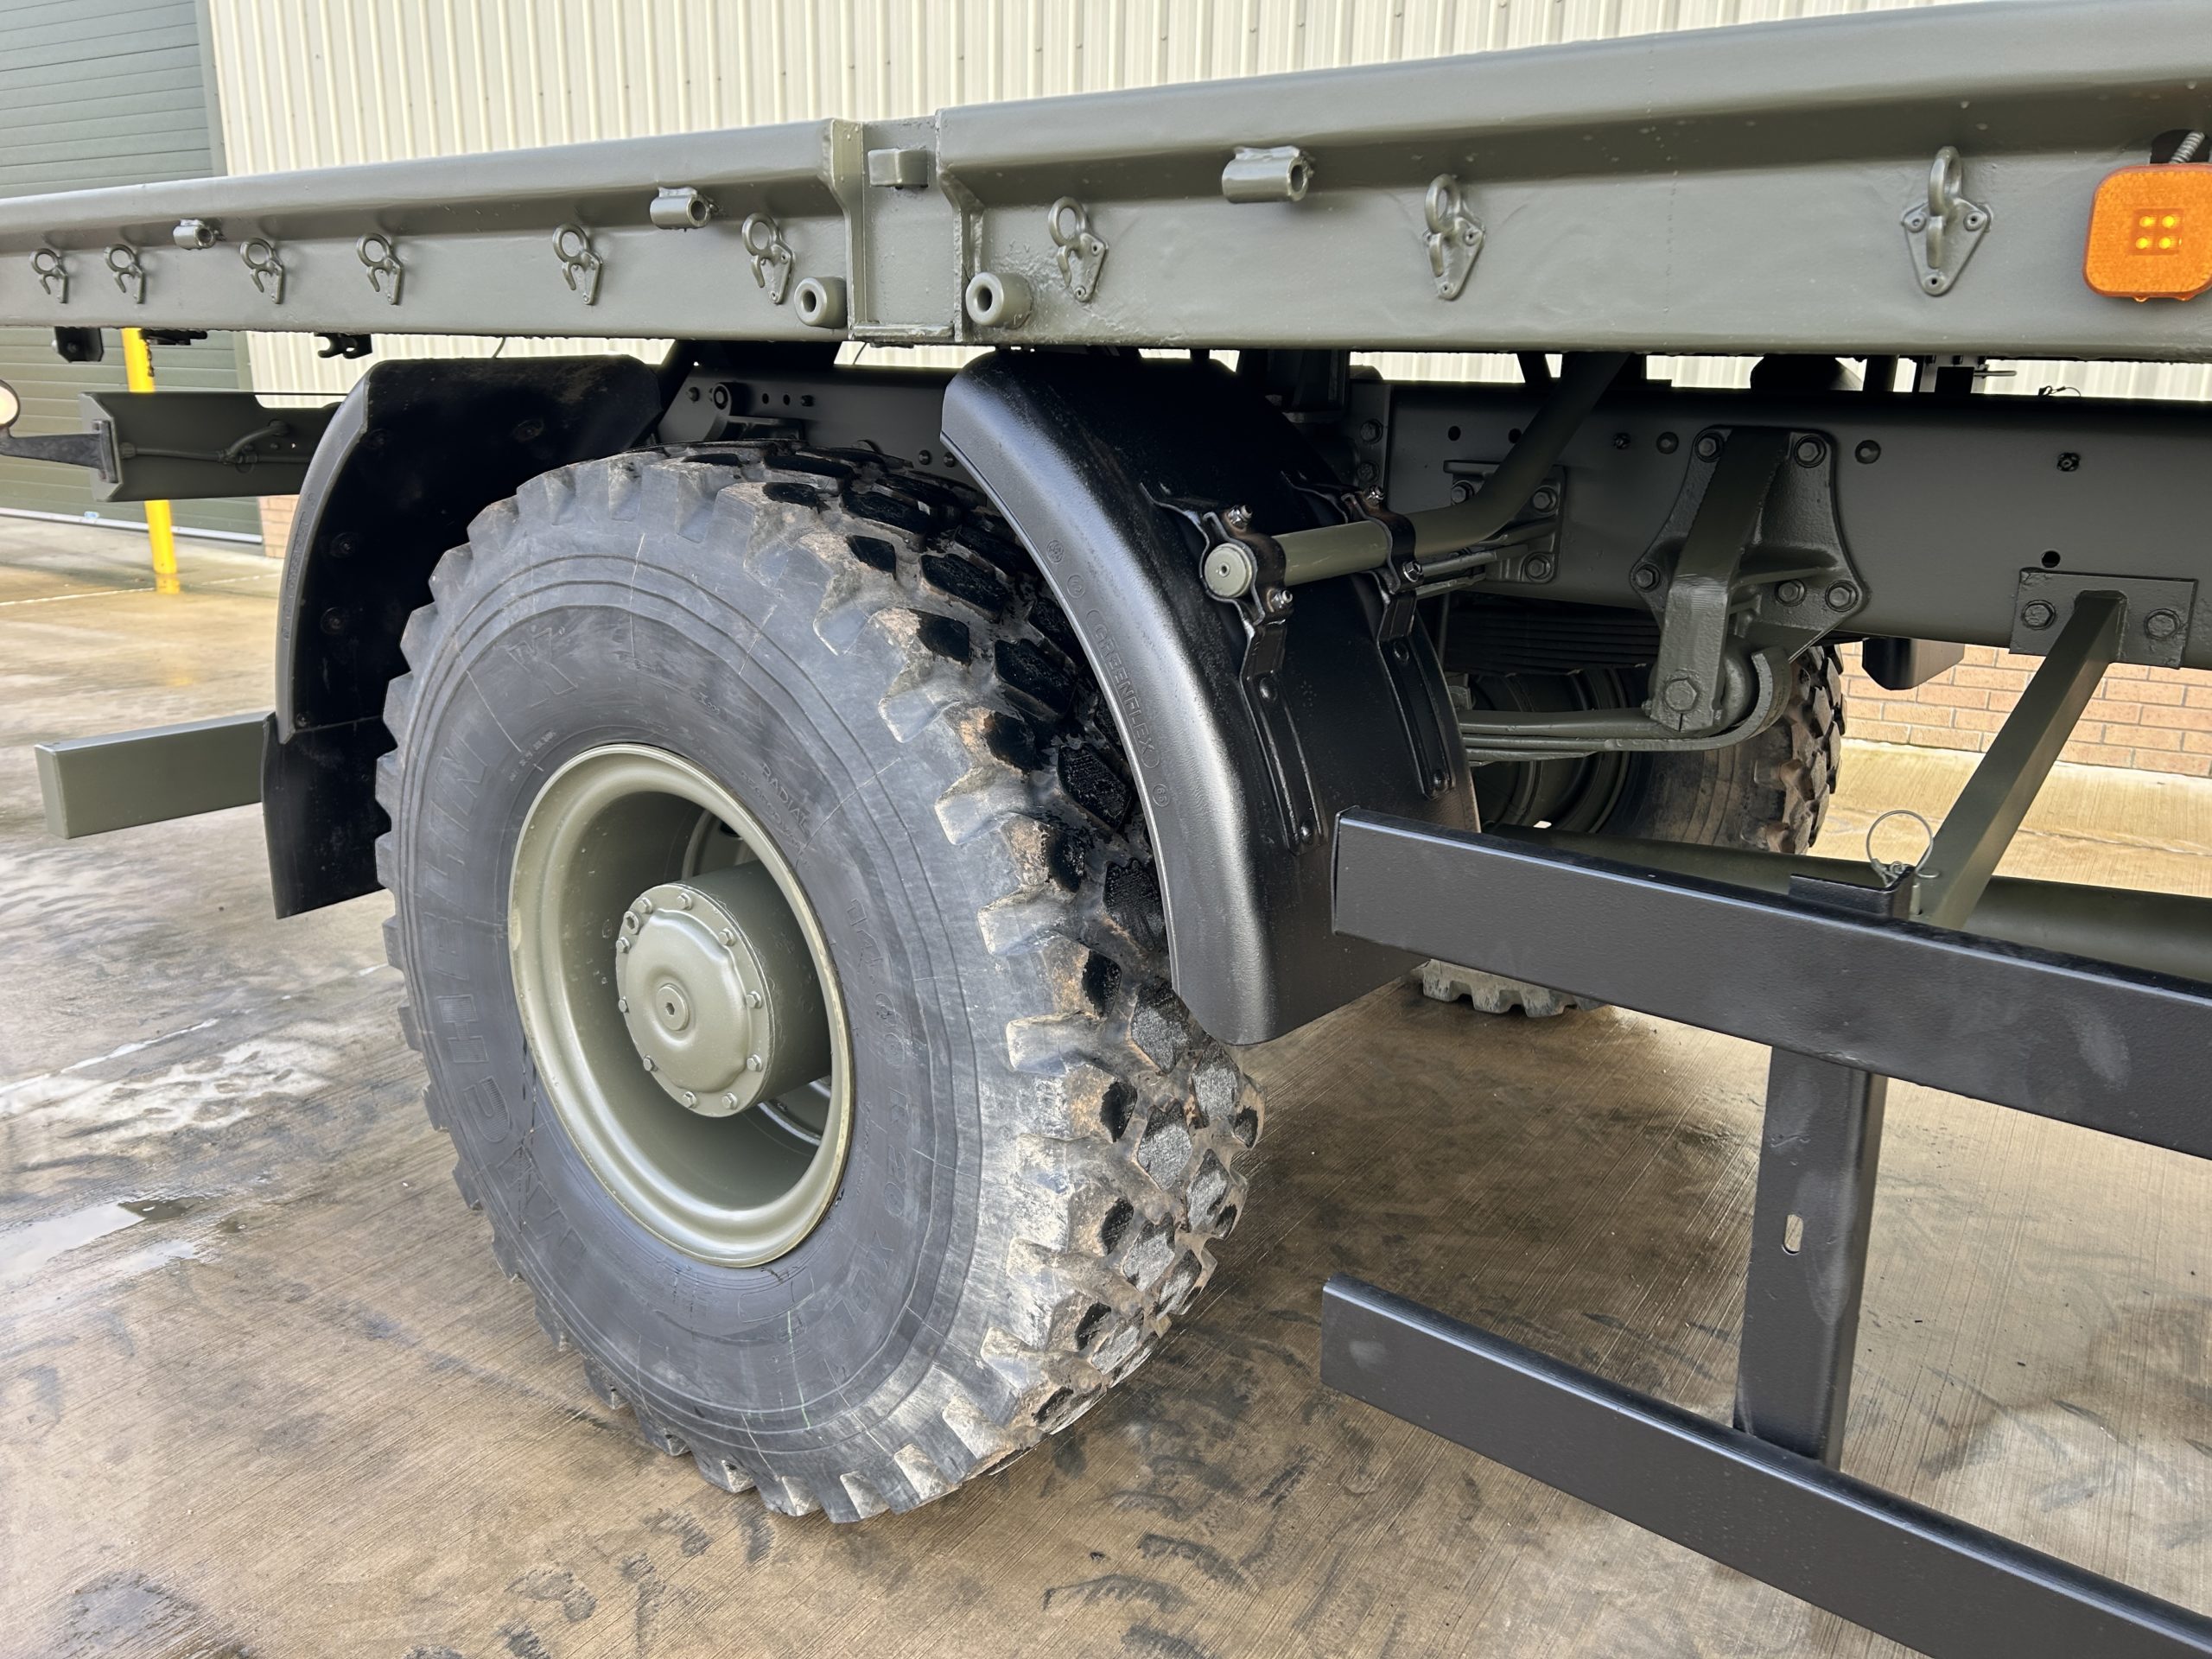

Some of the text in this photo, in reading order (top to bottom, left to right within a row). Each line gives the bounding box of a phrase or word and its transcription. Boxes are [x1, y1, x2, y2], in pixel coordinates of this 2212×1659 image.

[1095, 623, 1154, 754] GREENFLEX
[761, 762, 810, 833] RADIAL
[884, 1144, 907, 1218] 20
